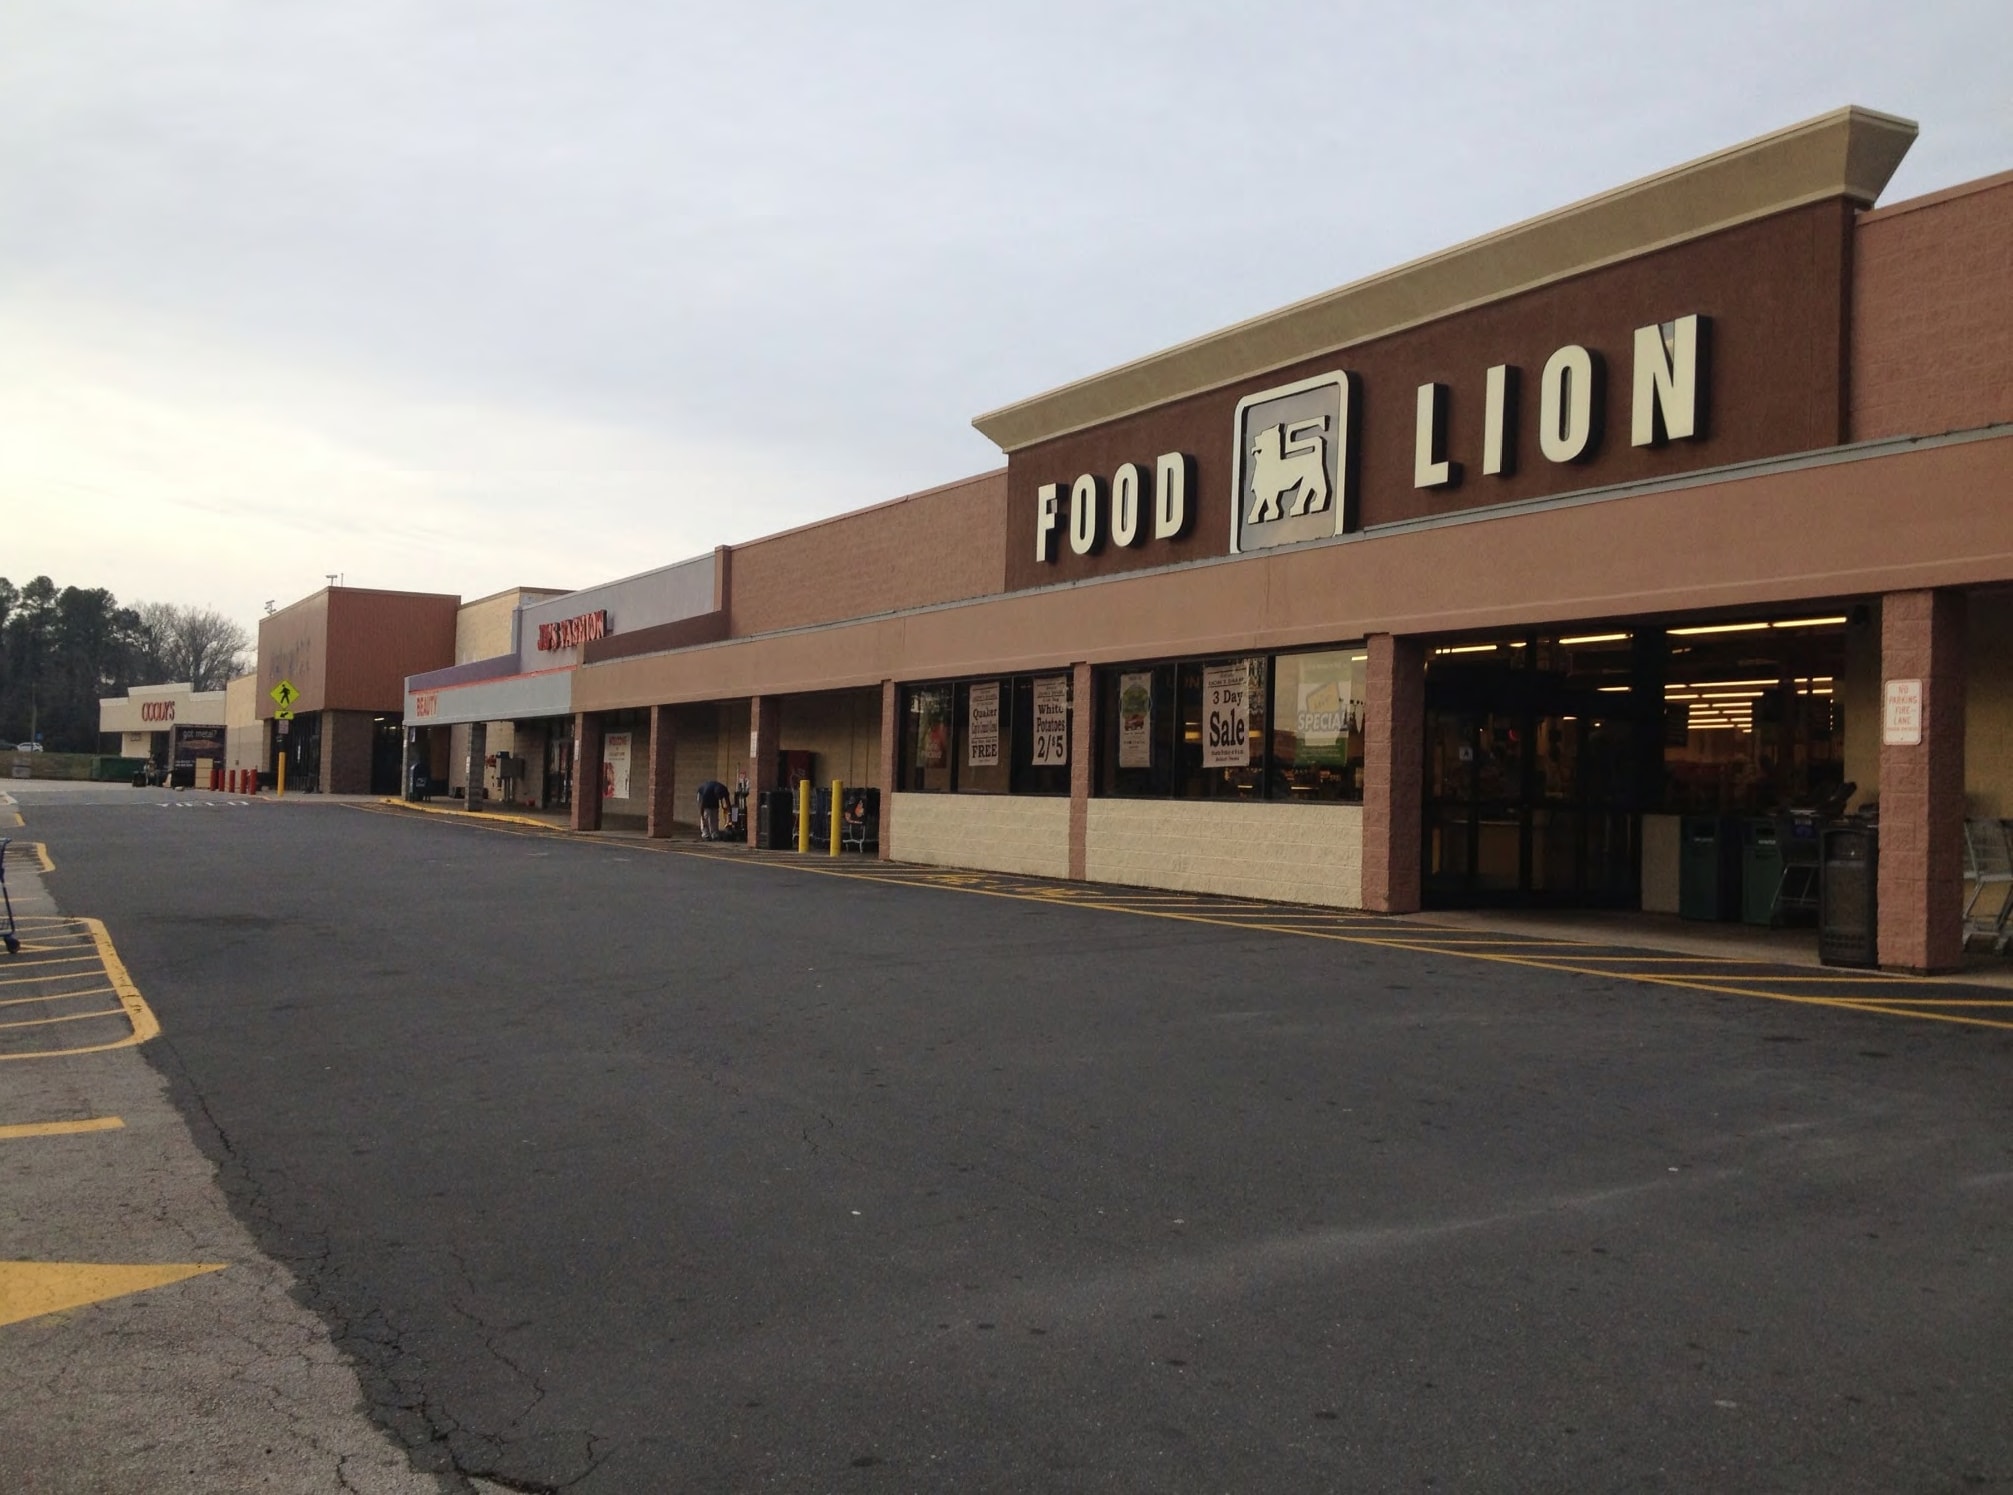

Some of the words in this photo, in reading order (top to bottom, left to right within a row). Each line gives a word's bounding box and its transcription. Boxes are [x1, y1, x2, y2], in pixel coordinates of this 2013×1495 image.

[1036, 450, 1196, 563] FOOD
[1413, 313, 1712, 491] LION
[559, 609, 607, 648] FASHION
[1899, 685, 1909, 694] NO
[1213, 690, 1220, 705] 3
[1223, 690, 1243, 707] Day
[1889, 695, 1919, 704] PARKING
[416, 694, 438, 717] BEAUTY
[1038, 703, 1063, 715] White
[1896, 705, 1911, 714] FIRE
[973, 708, 997, 720] Quaker
[1893, 716, 1911, 725] LANE
[1037, 717, 1065, 733] Potatoes
[1209, 707, 1245, 748] Sale
[183, 730, 194, 740] got
[972, 744, 997, 758] FREE
